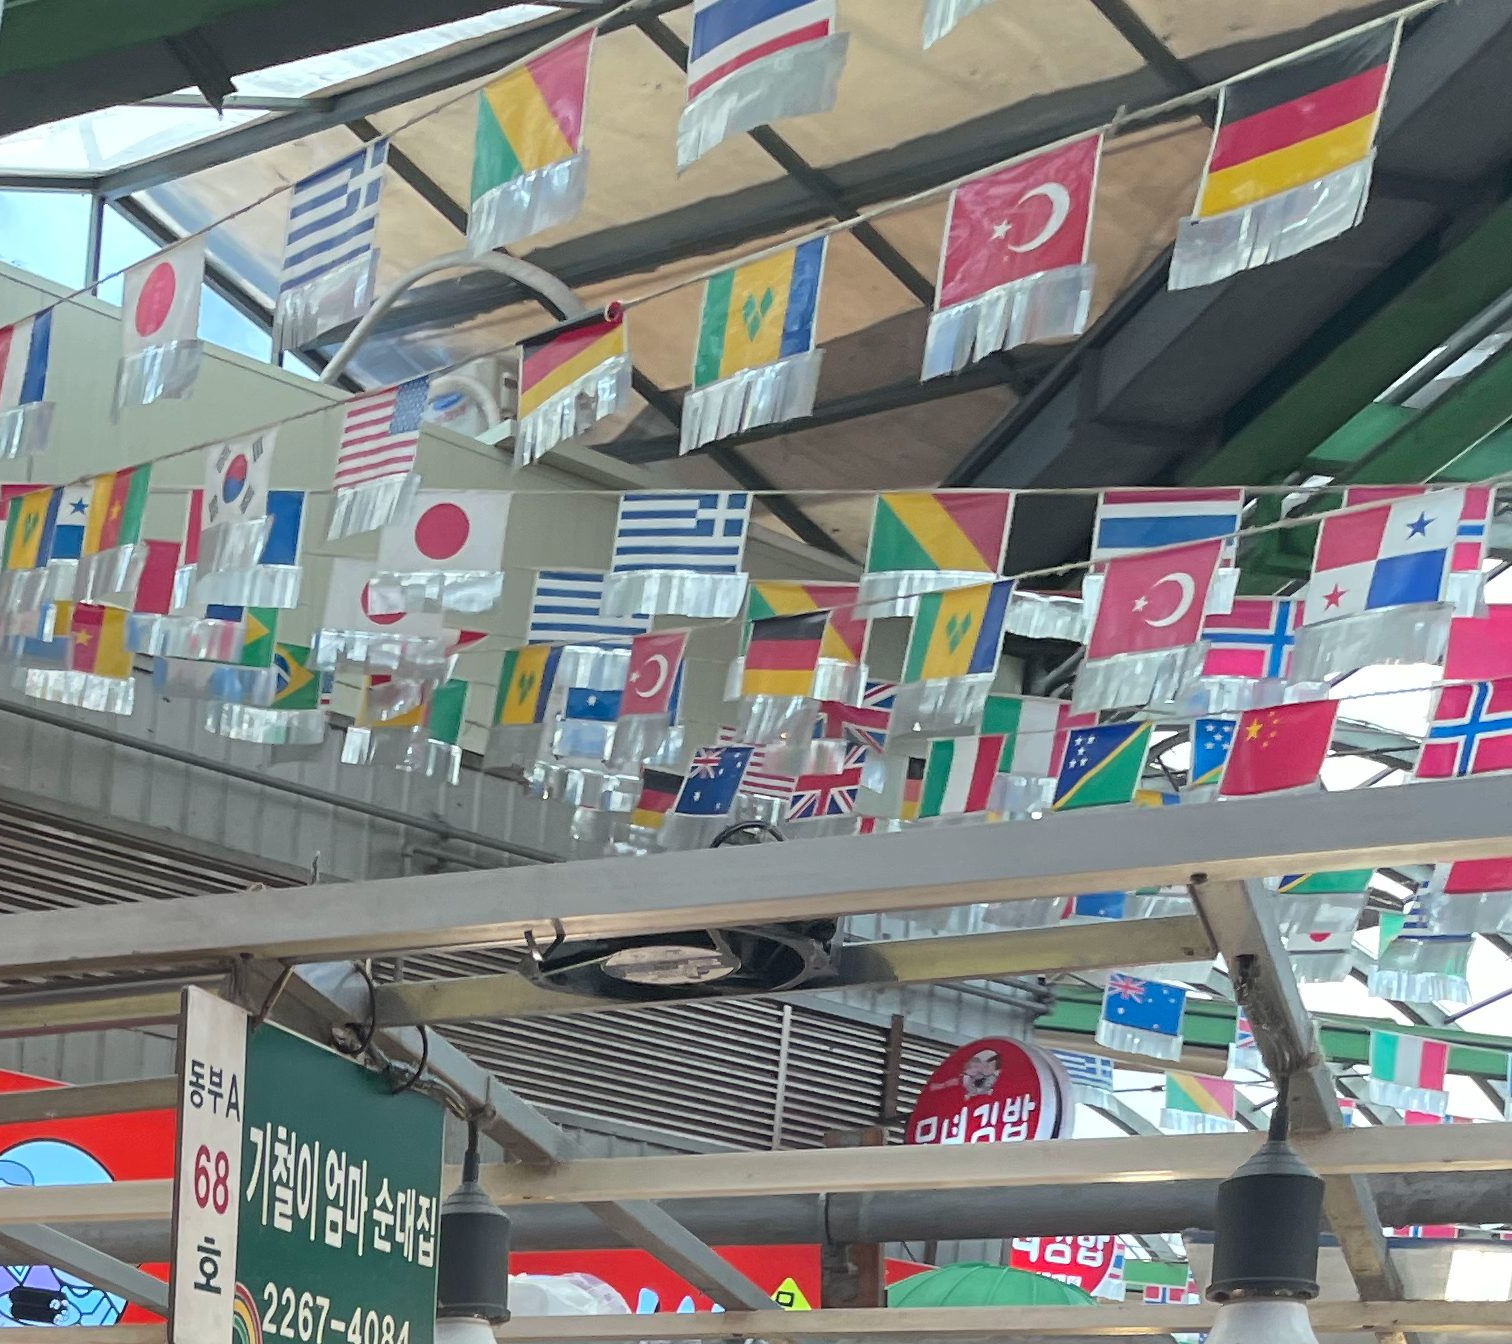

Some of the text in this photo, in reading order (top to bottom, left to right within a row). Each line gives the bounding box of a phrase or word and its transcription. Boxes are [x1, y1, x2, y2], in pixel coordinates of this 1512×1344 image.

[188, 1060, 241, 1122] 동부A
[194, 1144, 230, 1216] 68
[246, 1121, 438, 1269] 기철이 엄마 순대집
[193, 1236, 223, 1295] 호
